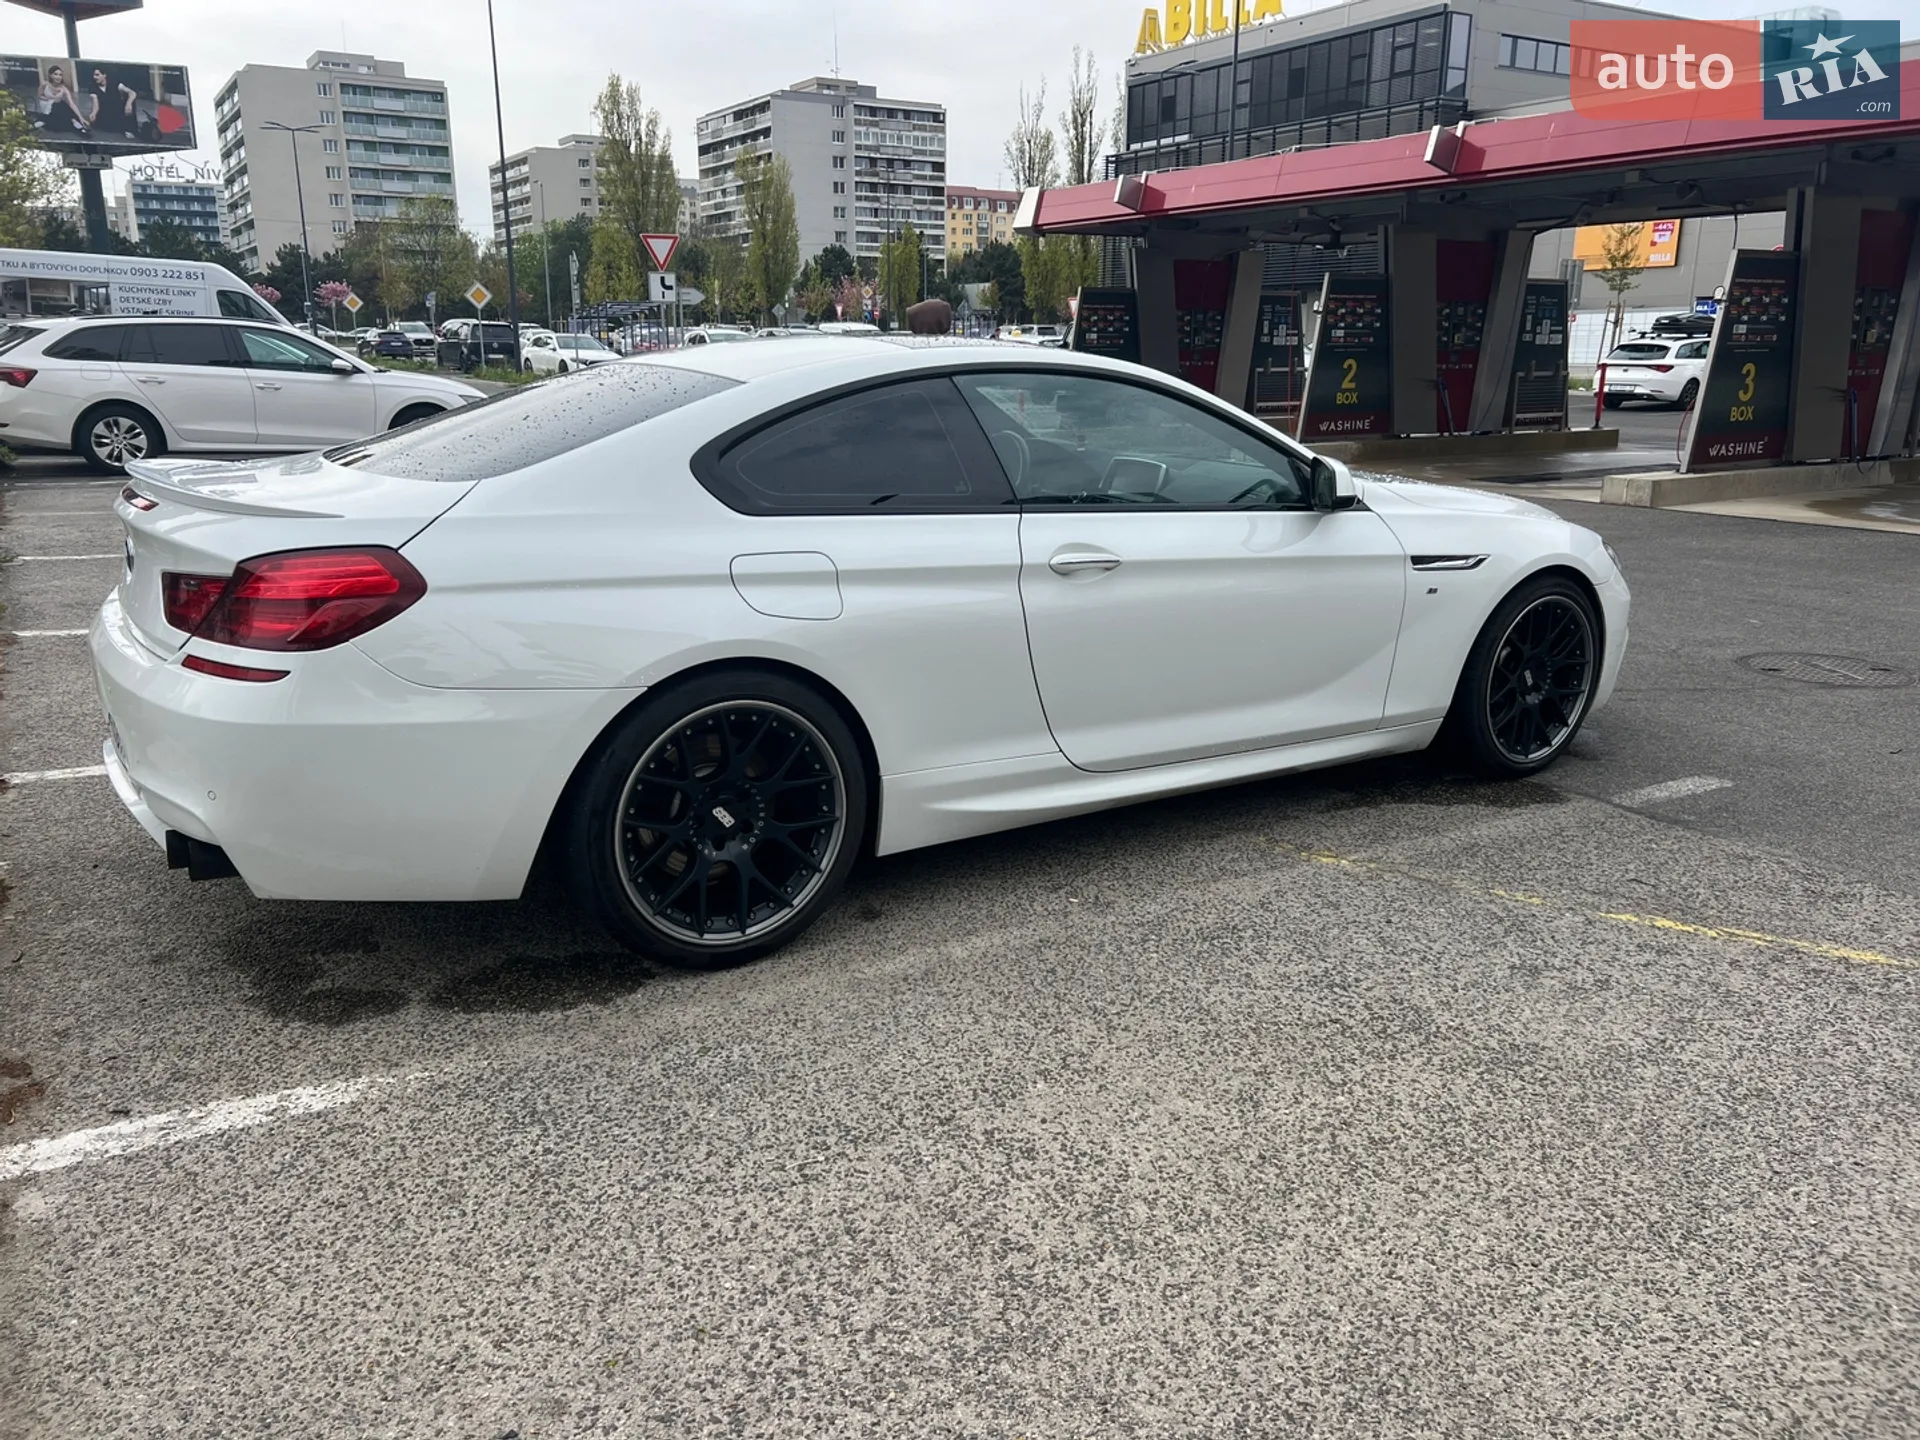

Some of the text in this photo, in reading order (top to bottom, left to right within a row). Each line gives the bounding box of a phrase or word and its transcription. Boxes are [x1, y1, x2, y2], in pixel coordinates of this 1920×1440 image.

[131, 164, 185, 179] HOTEL
[21, 261, 28, 269] A
[129, 266, 159, 278] 0903
[162, 269, 183, 280] 222
[185, 271, 205, 281] 851
[172, 289, 197, 297] LINKY
[1341, 358, 1357, 389] 2
[1738, 362, 1756, 402] 3
[1335, 391, 1359, 404] BOX
[1729, 405, 1755, 421] BOX
[1318, 419, 1371, 432] WASHINE
[1708, 440, 1765, 457] WASHINE
